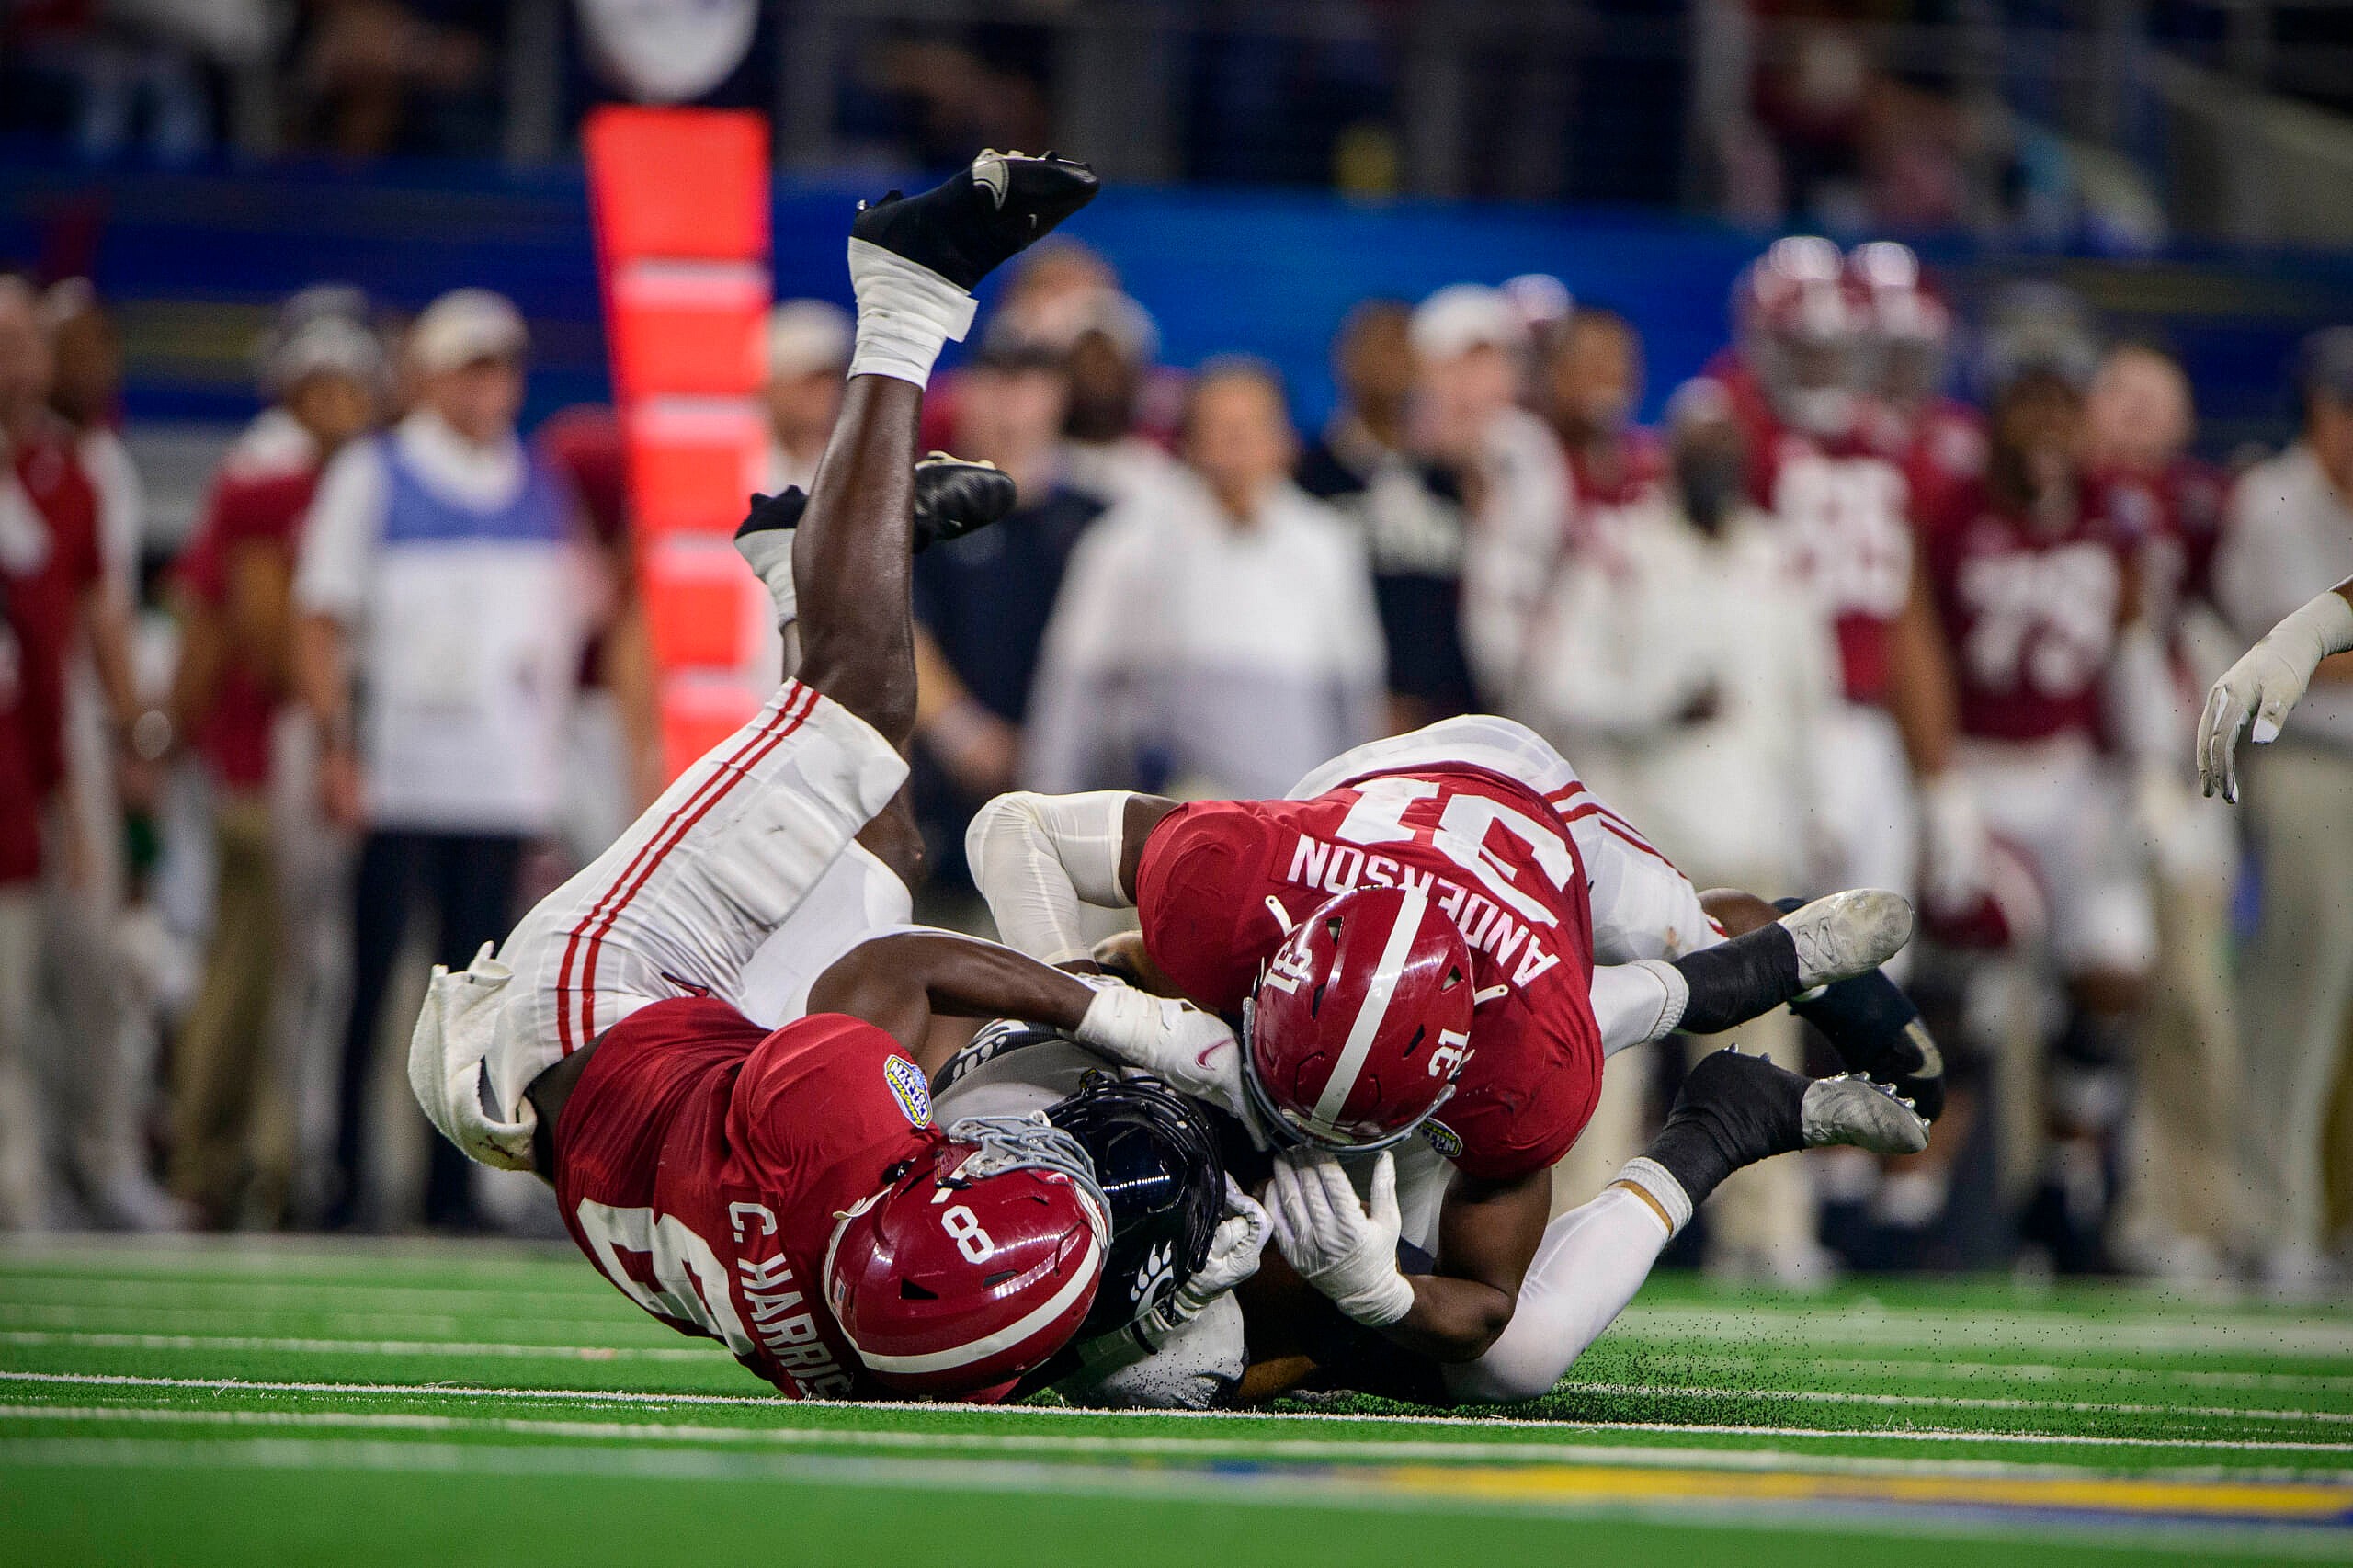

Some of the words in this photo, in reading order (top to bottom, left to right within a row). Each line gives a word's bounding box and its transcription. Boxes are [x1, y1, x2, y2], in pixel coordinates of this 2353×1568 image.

[1335, 777, 1574, 929] 31
[1262, 937, 1313, 995] 31
[1428, 1028, 1471, 1080] 31
[729, 1201, 778, 1243] C.
[940, 1204, 995, 1265] 8
[576, 1197, 756, 1357] 8
